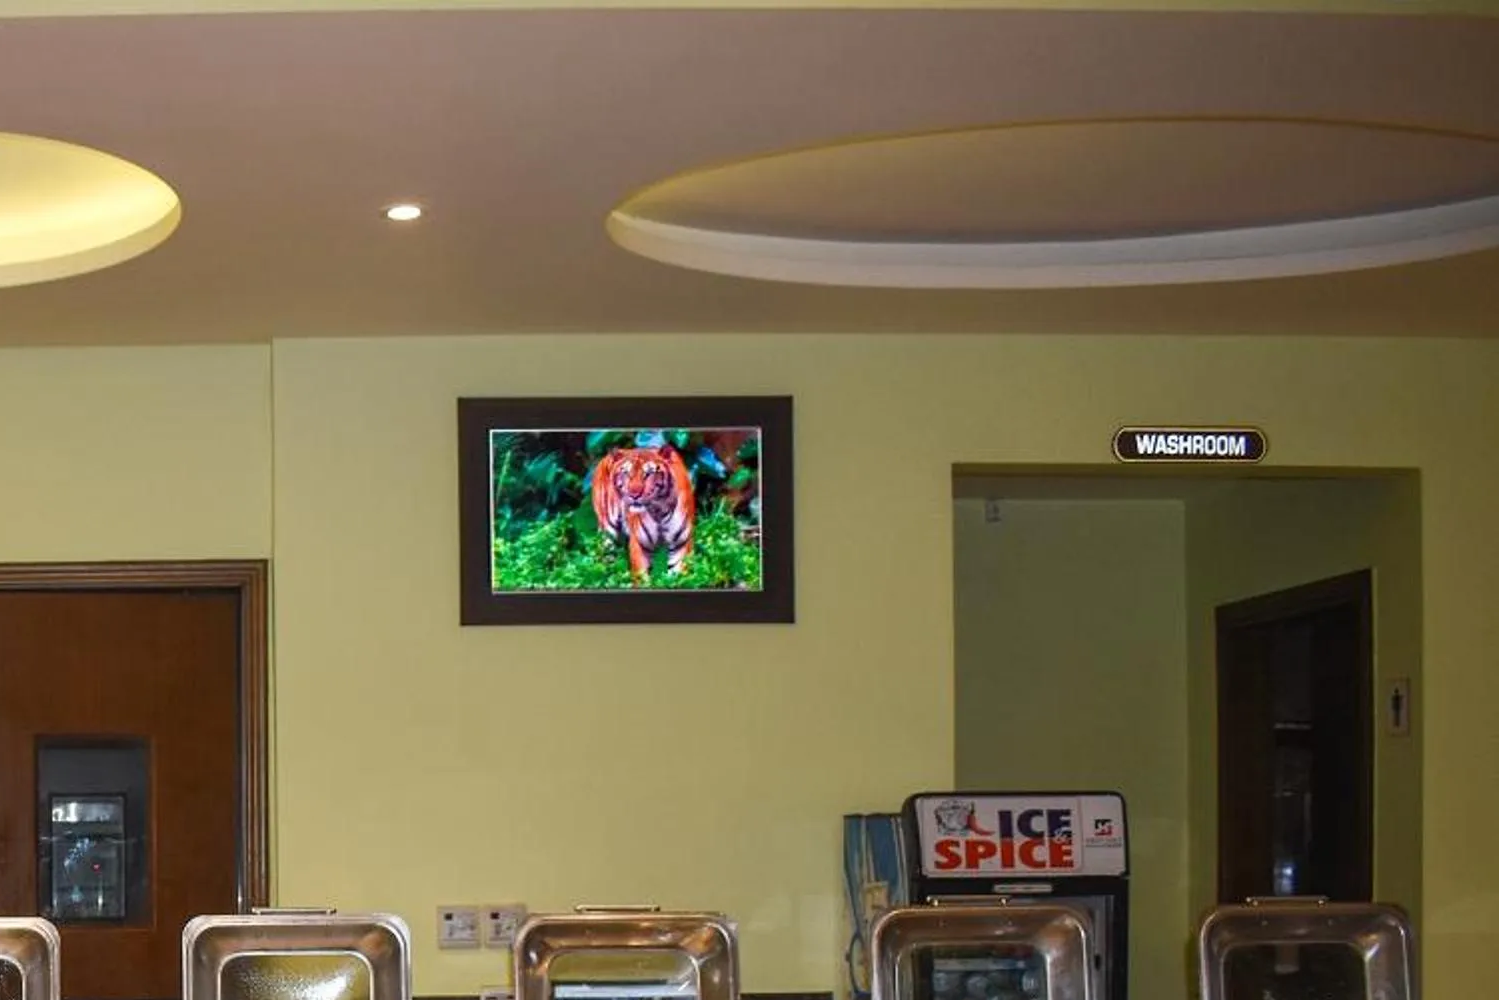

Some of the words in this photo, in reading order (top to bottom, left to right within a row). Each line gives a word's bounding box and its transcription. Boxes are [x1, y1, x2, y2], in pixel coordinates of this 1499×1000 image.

[1135, 433, 1246, 457] WASHROOM
[997, 808, 1073, 839] ICE
[934, 838, 1074, 870] SPICE
